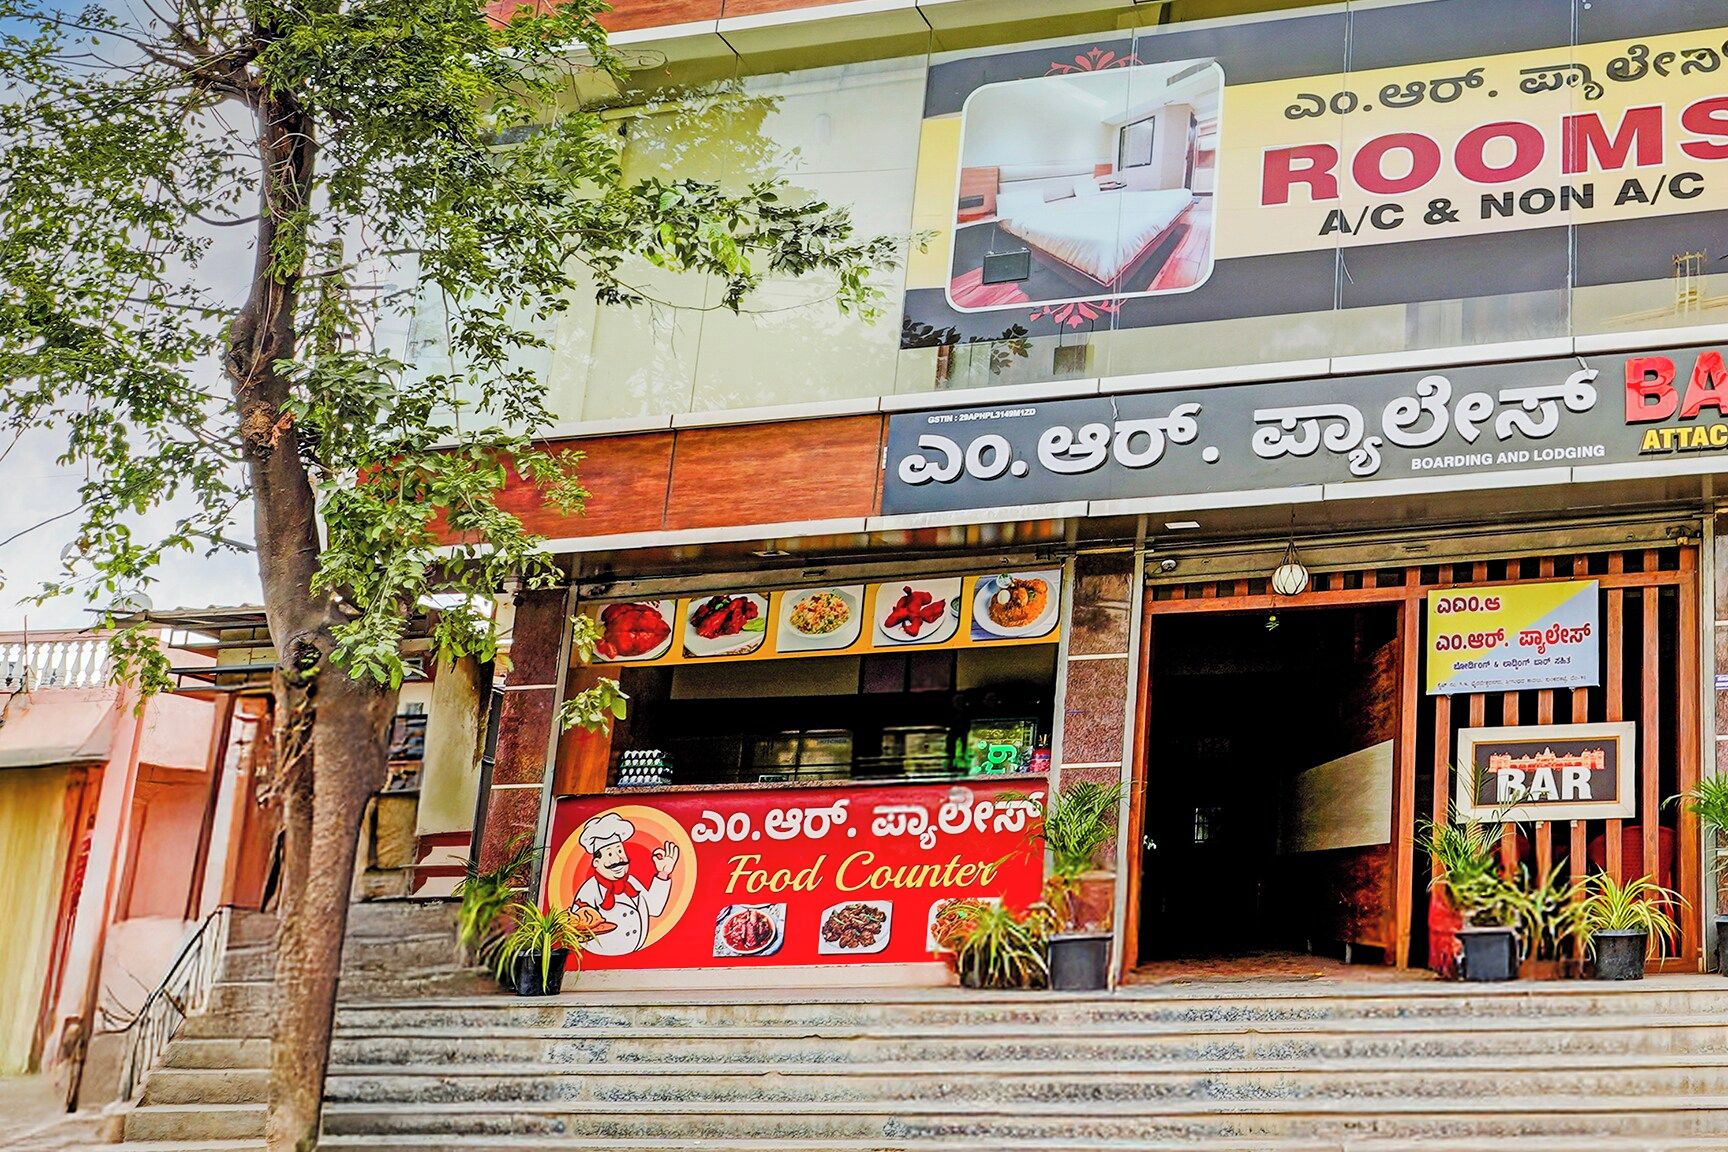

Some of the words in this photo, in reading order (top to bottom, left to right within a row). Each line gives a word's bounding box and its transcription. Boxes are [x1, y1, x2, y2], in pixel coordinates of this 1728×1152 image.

[1319, 203, 1404, 236] A/C
[1424, 198, 1459, 225] &
[1481, 182, 1594, 219] NON
[1614, 172, 1706, 206] A/C
[928, 415, 953, 424] GSTIN
[1411, 453, 1494, 470] BOARDING
[1497, 450, 1530, 465] AND
[1534, 445, 1605, 463] LODGING
[1497, 766, 1593, 803] BAR
[724, 853, 827, 895] Food
[835, 850, 1000, 892] Counter
